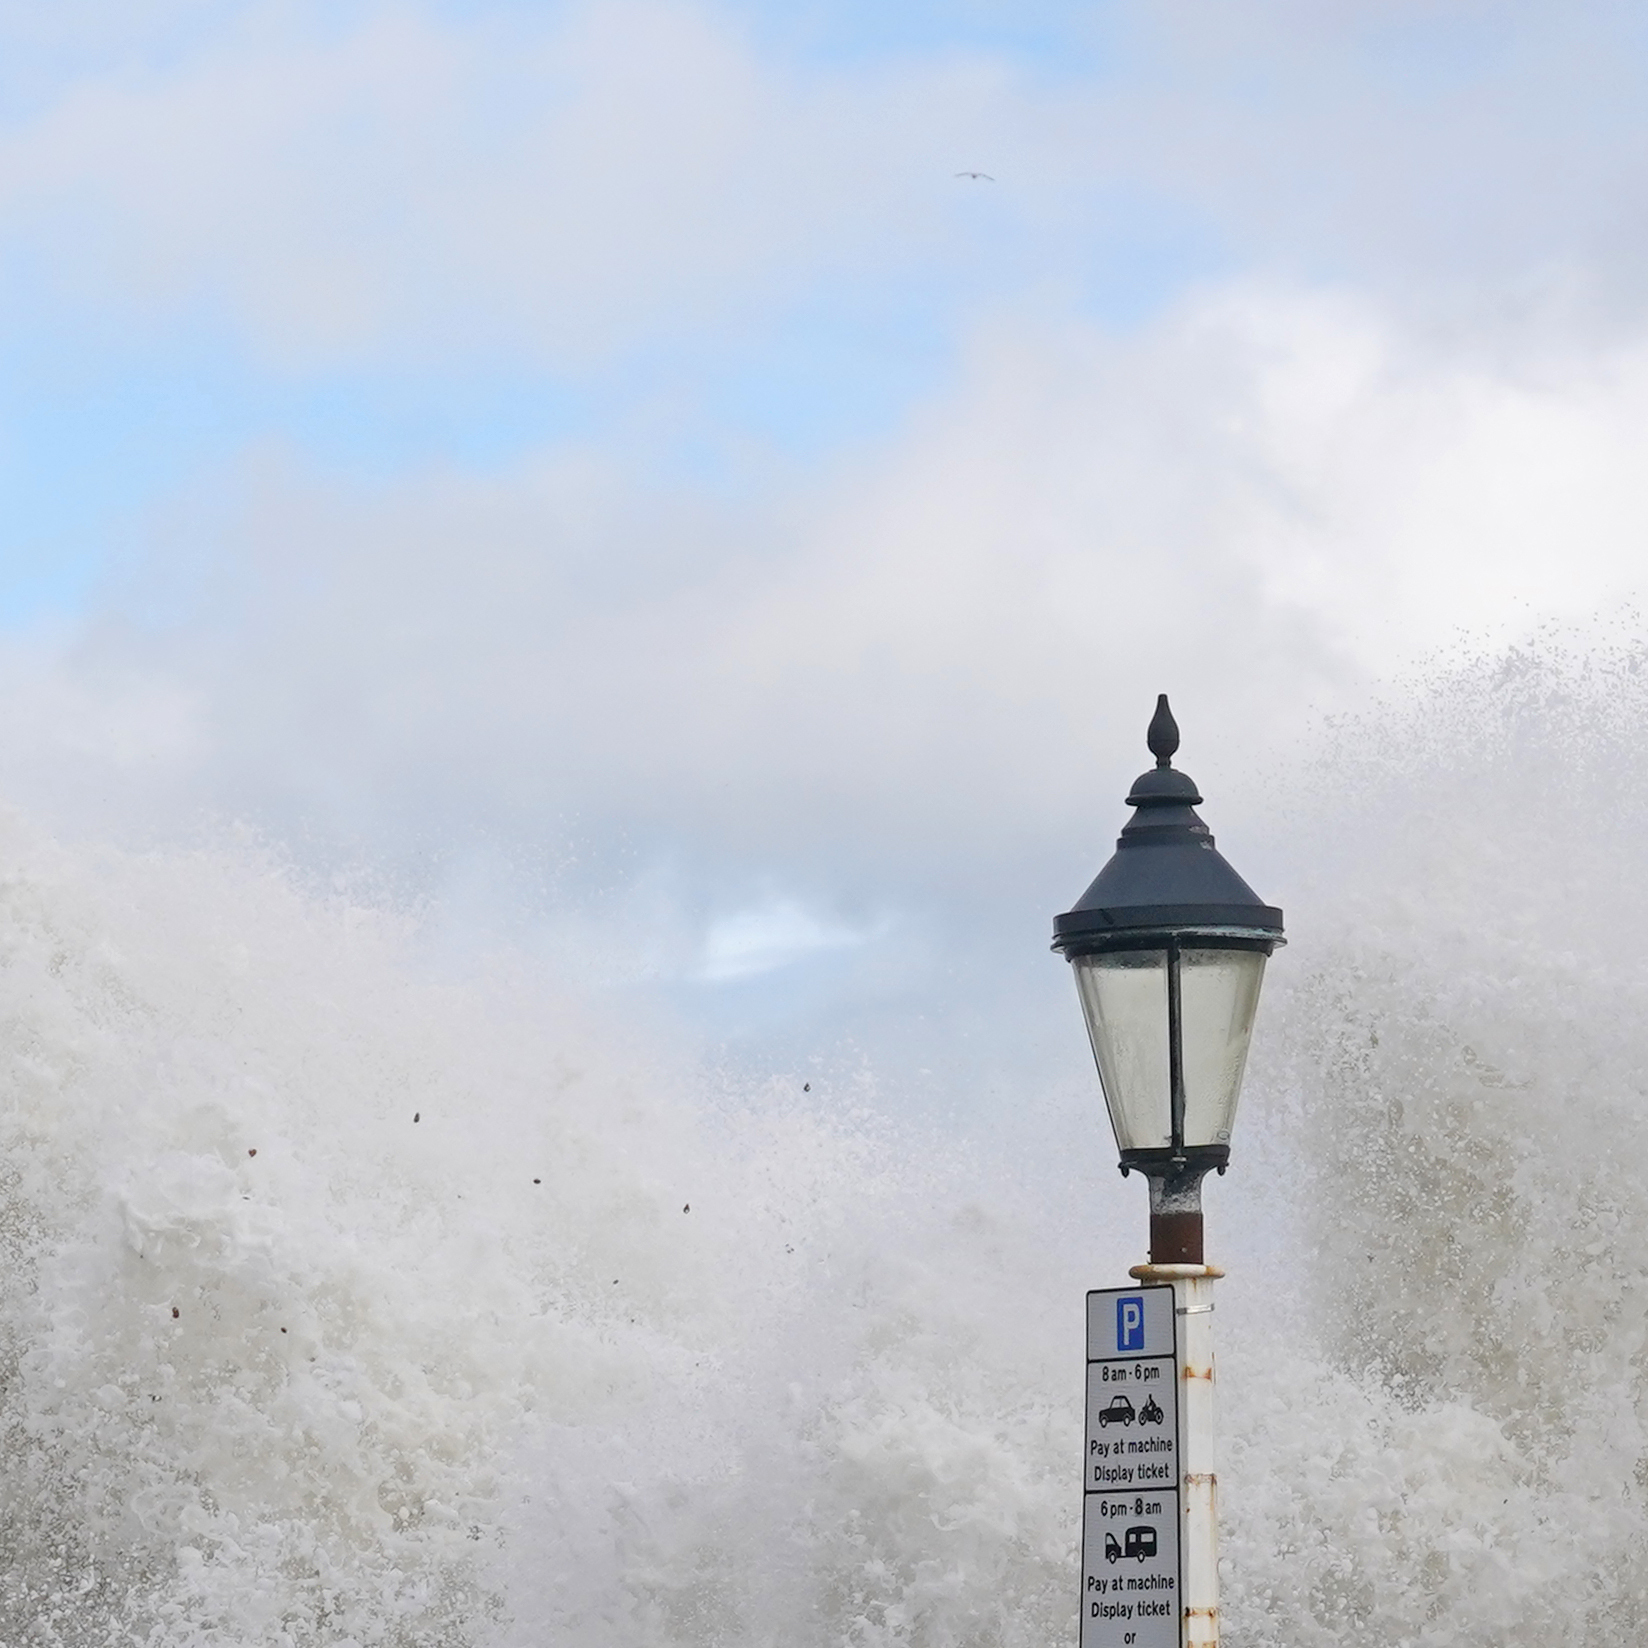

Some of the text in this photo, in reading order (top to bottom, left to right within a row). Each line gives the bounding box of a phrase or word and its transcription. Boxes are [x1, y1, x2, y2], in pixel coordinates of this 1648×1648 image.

[1123, 1303, 1140, 1346] P
[1090, 1436, 1173, 1458] Pay at machine
[1094, 1463, 1169, 1483] Display ticket
[1088, 1574, 1175, 1594] Pay at machine
[1091, 1600, 1171, 1620] Display ticket
[1124, 1632, 1136, 1645] or
